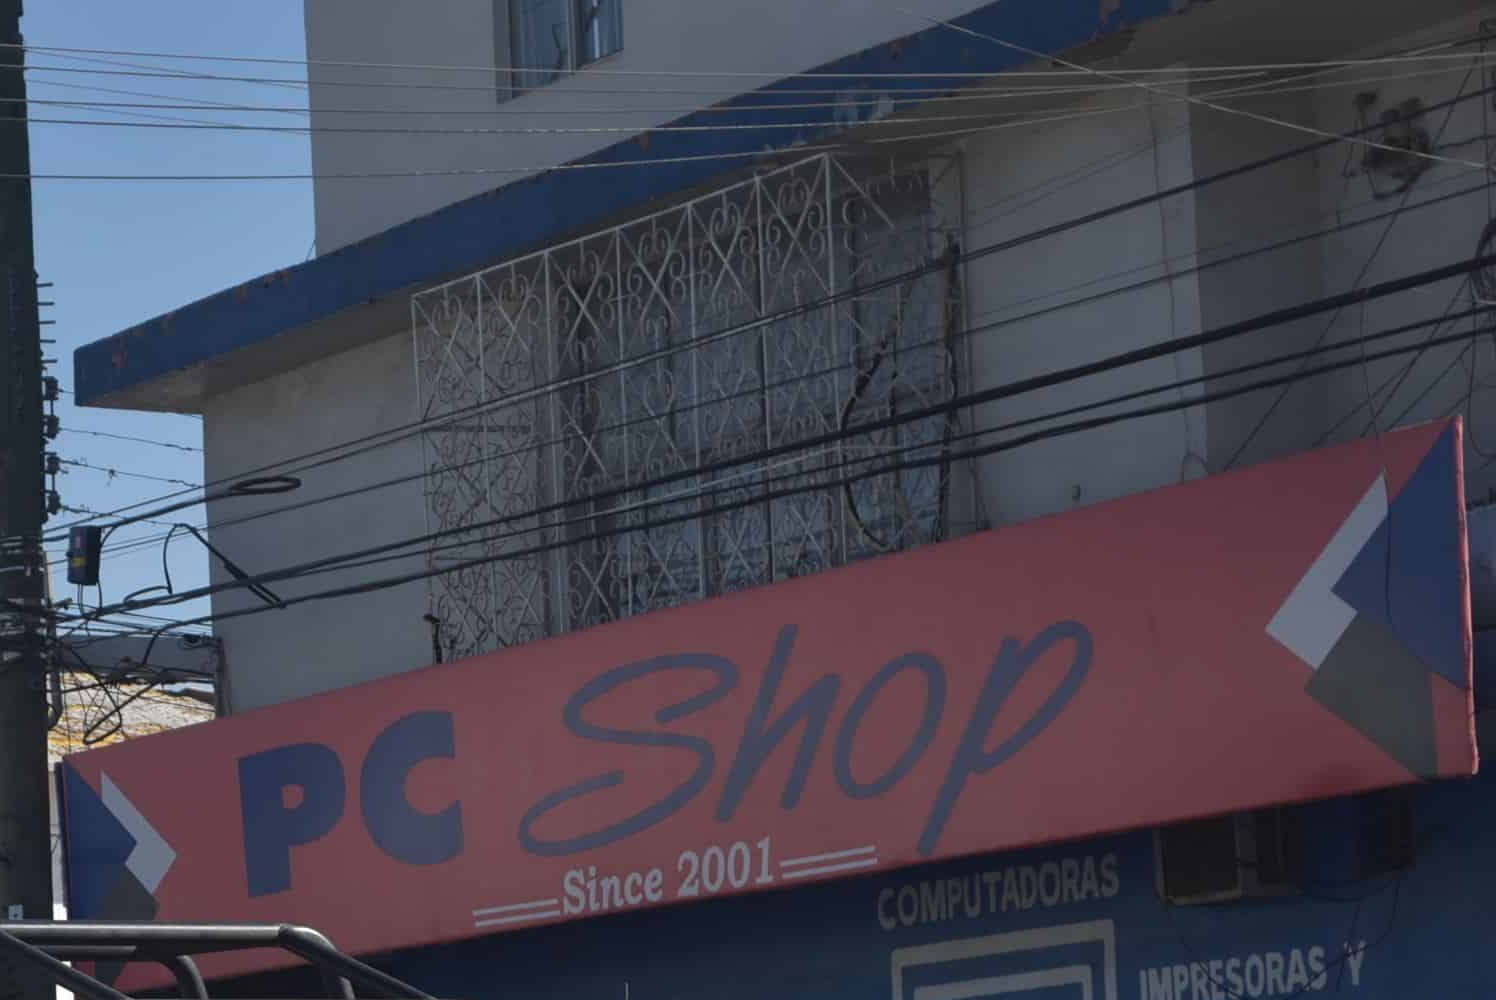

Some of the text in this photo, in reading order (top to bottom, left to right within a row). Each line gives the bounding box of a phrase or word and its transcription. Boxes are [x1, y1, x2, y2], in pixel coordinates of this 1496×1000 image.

[237, 619, 1095, 899] PC Shop
[562, 836, 775, 915] Since 2001
[877, 853, 1120, 930] COMPUTADORAS
[1343, 940, 1367, 986] Y
